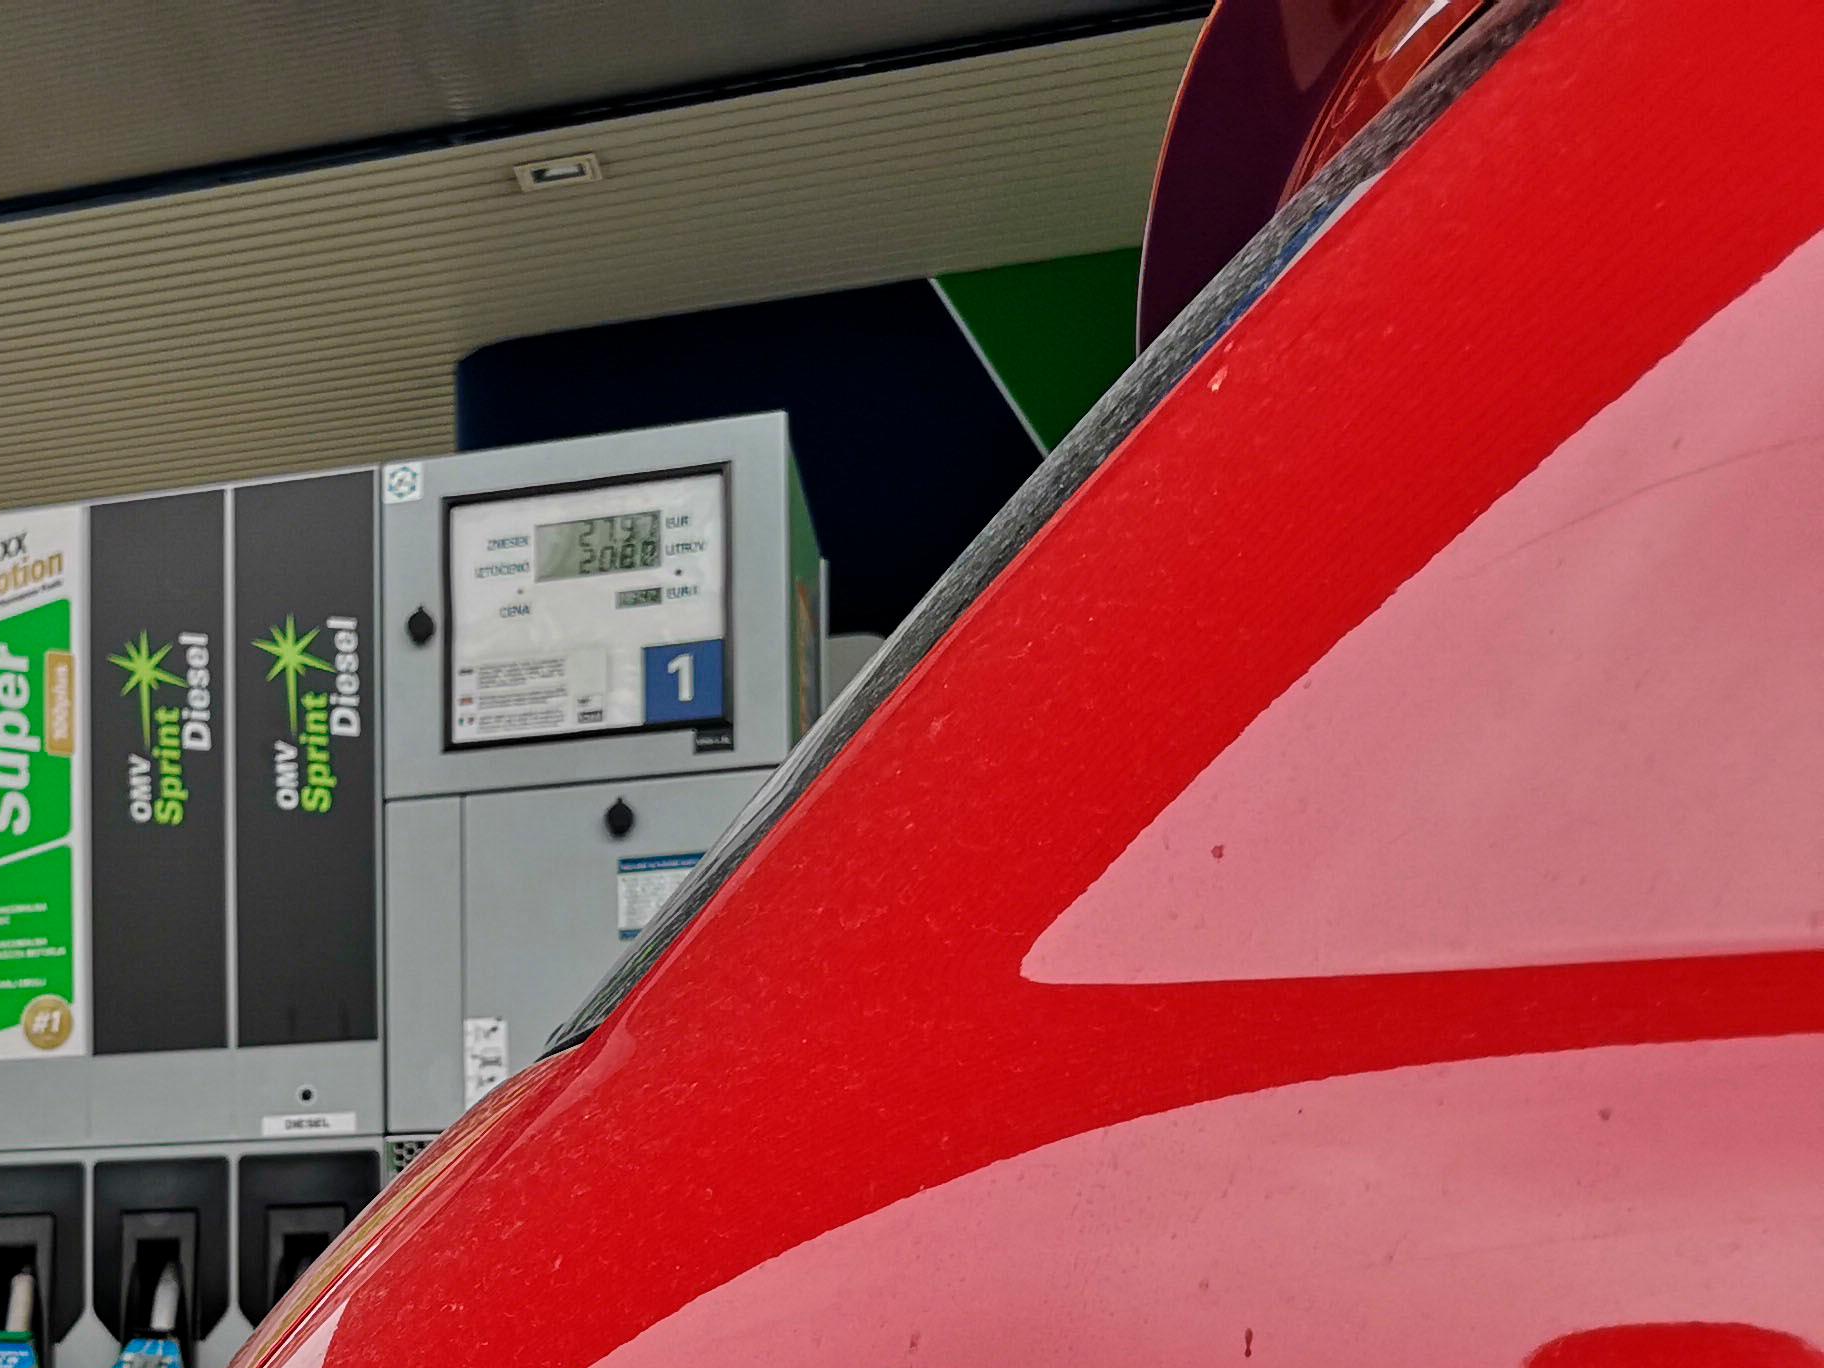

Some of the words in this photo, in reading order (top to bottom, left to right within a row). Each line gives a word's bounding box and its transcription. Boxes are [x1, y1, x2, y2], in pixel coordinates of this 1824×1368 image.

[178, 632, 212, 751] Diesel
[326, 615, 362, 737] Diesel
[667, 653, 694, 702] 1
[128, 753, 152, 823] OMV
[151, 706, 189, 825] Sprint
[273, 739, 299, 810] OMV
[299, 691, 337, 813] Sprint
[32, 1010, 61, 1034] #1
